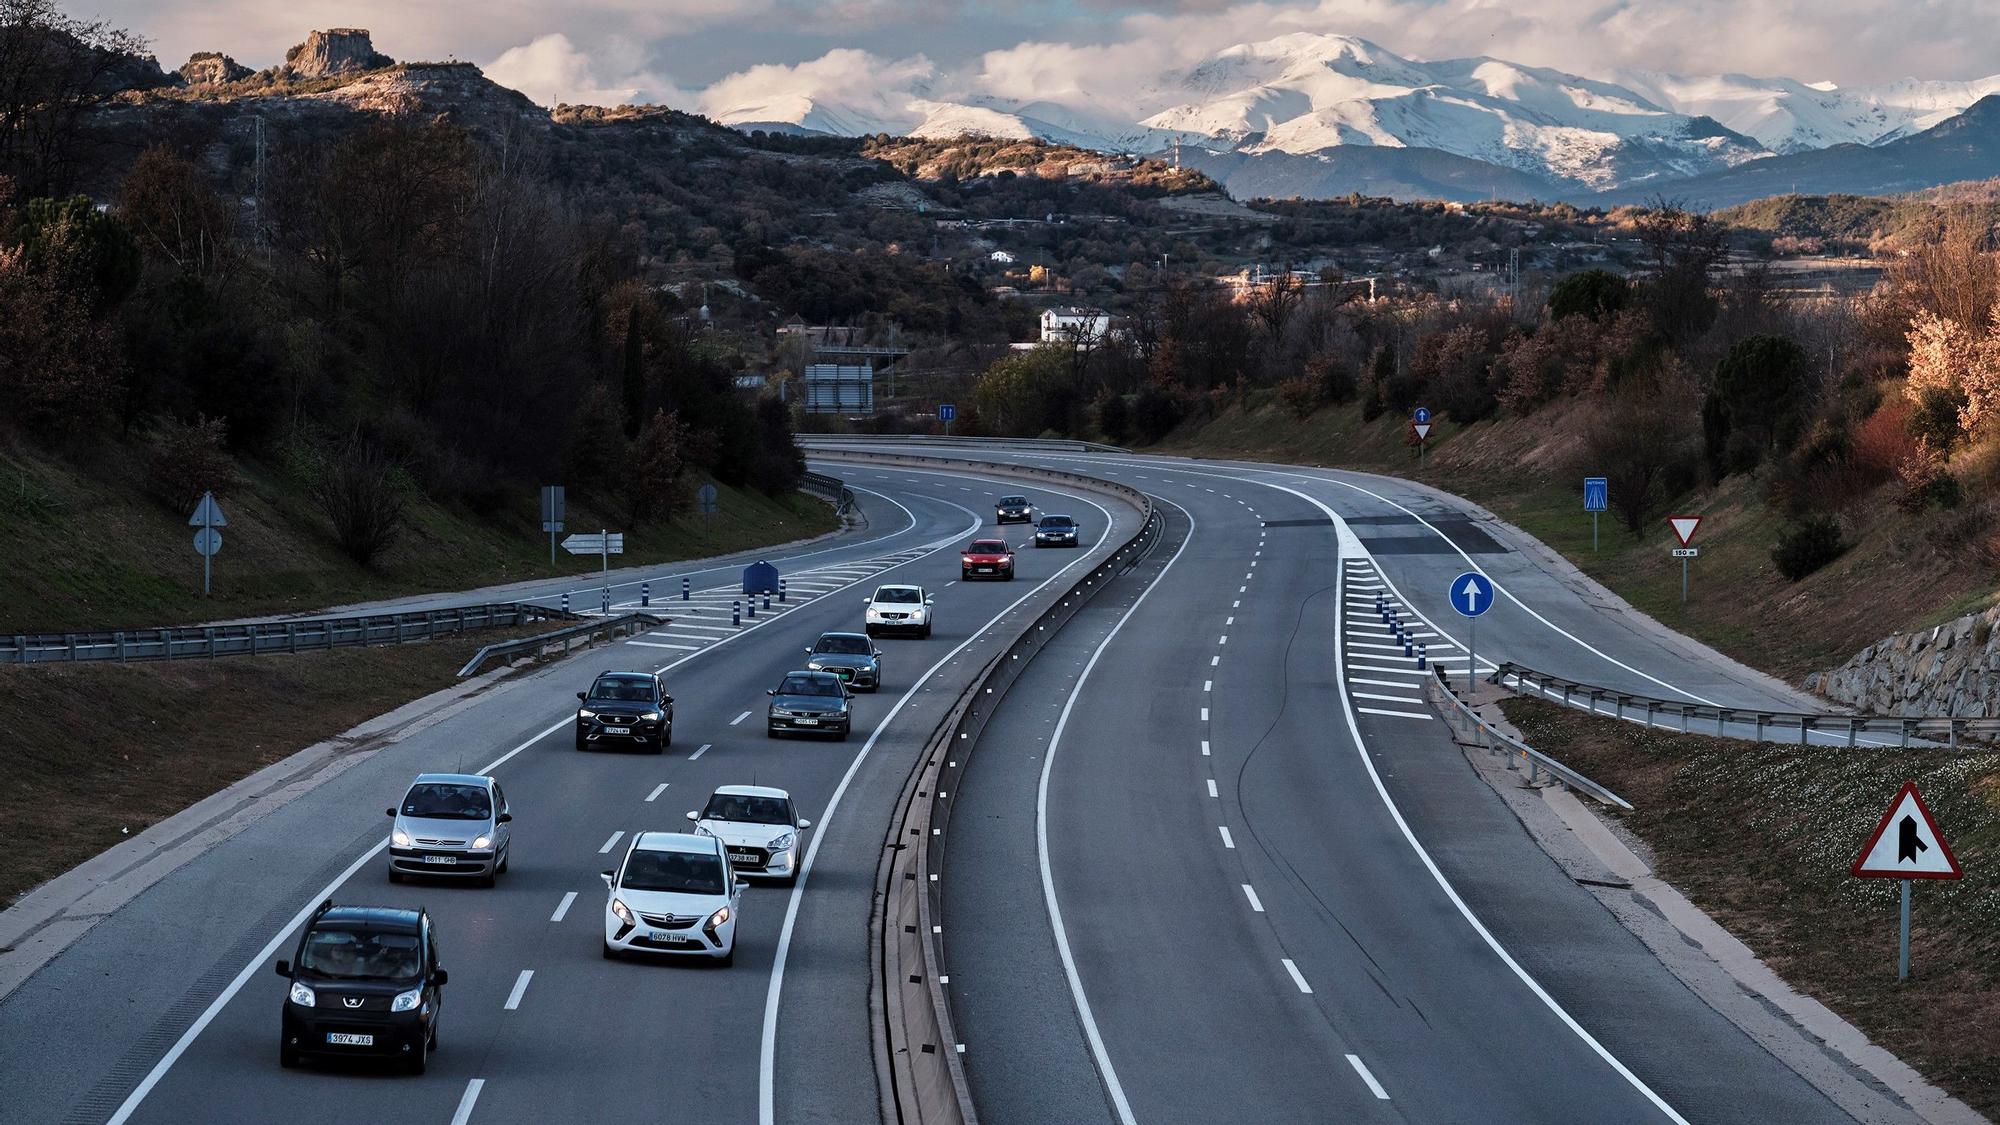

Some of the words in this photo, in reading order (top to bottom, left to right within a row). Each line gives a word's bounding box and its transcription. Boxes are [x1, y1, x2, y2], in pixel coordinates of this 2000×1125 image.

[653, 932, 671, 941] 6078
[672, 934, 687, 942] HVM
[332, 1033, 353, 1043] 3974
[355, 1035, 372, 1045] JXS
